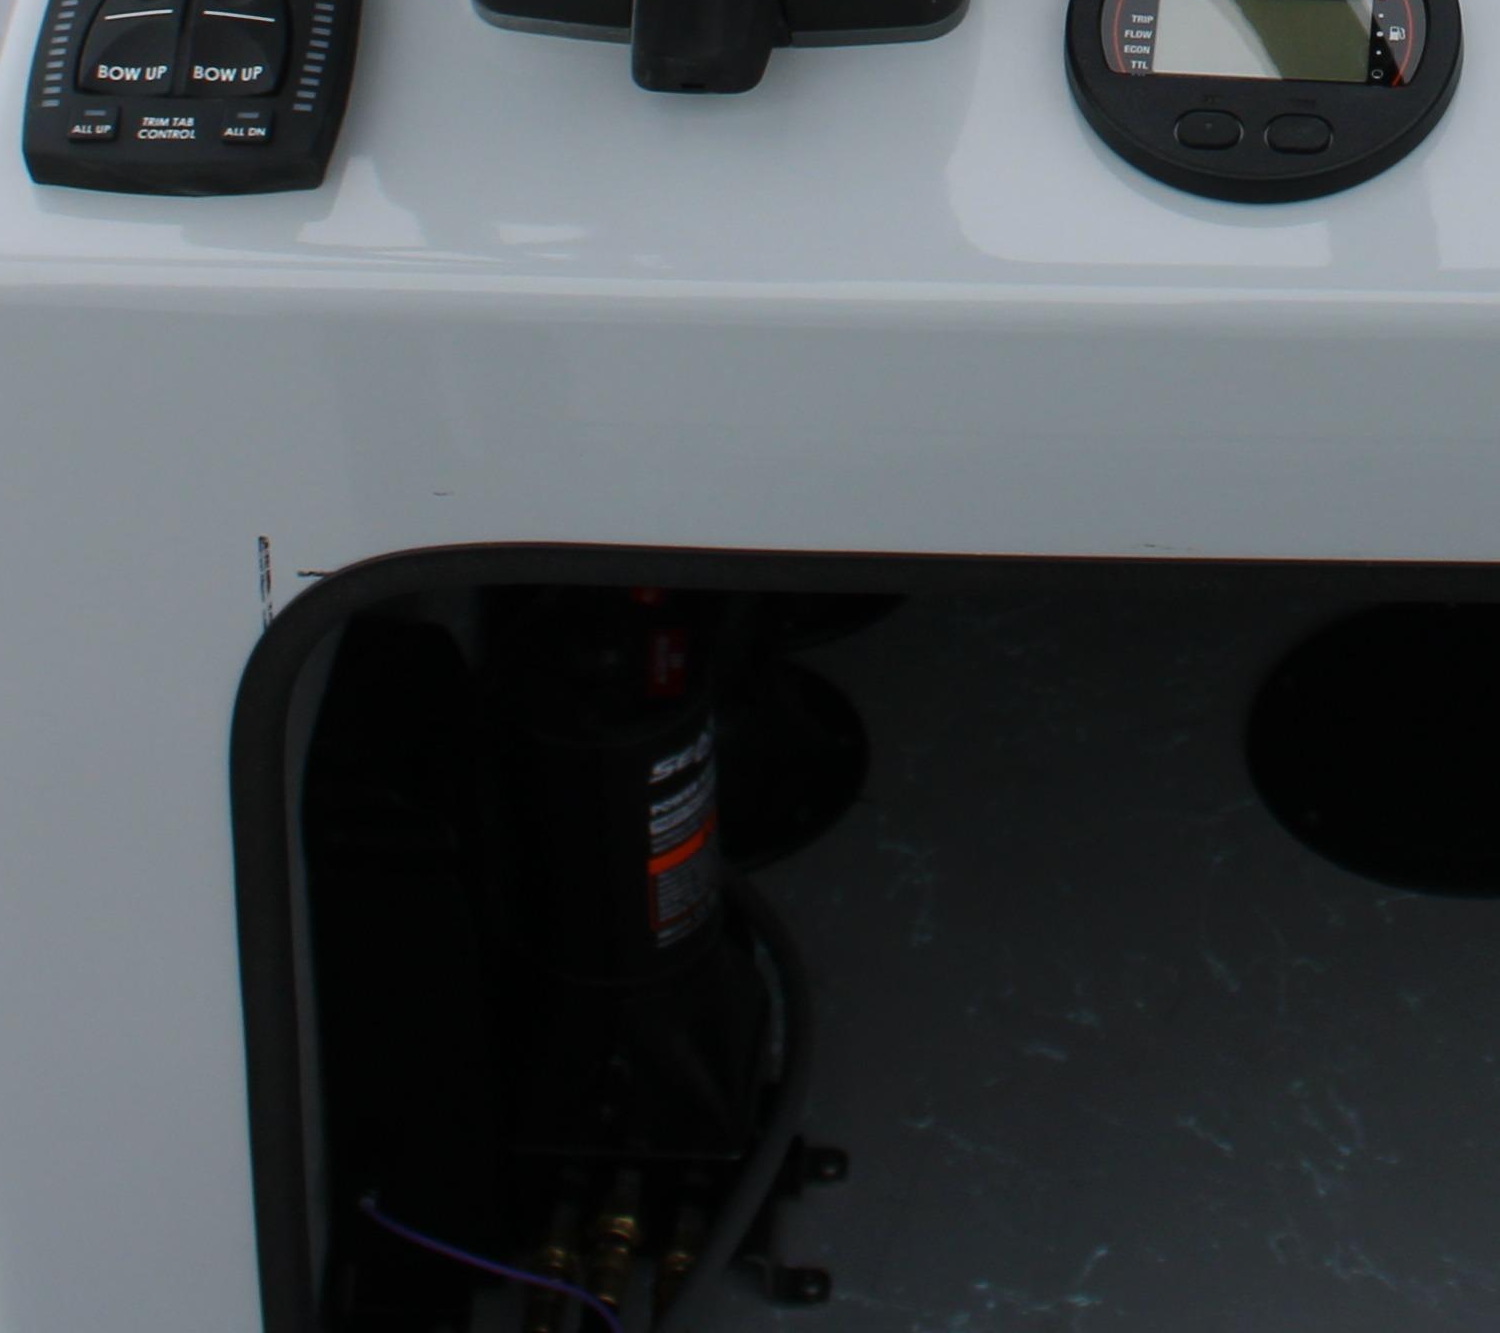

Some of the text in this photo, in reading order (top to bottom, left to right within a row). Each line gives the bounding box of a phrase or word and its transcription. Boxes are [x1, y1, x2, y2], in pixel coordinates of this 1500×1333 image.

[1131, 14, 1154, 23] TRIP
[1124, 29, 1153, 39] FLOW
[1123, 44, 1151, 54] ECON
[1131, 60, 1149, 70] TTL
[97, 65, 168, 81] BOW UP
[193, 65, 263, 82] BOW UP
[141, 117, 195, 127] TRIM TAB
[71, 124, 112, 134] ALL UP
[137, 128, 196, 140] CONTROL
[224, 127, 266, 137] ALL DN
